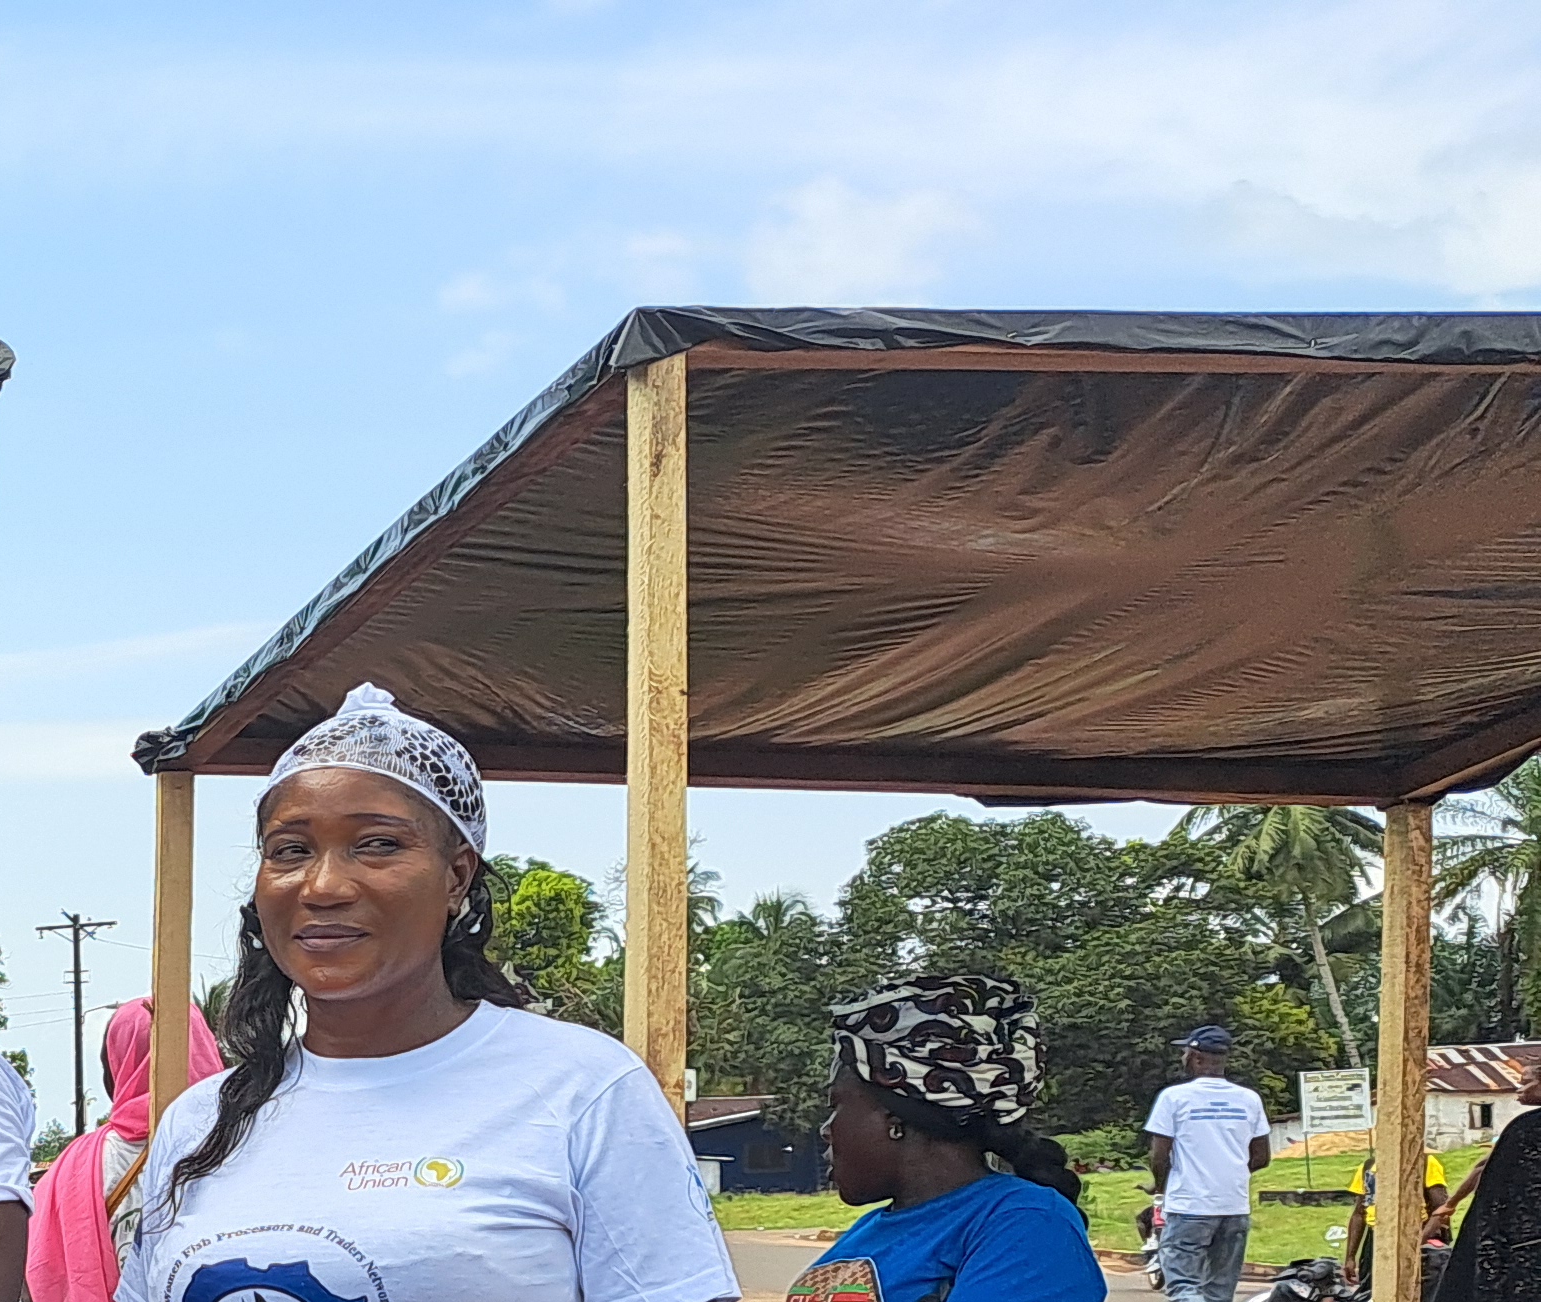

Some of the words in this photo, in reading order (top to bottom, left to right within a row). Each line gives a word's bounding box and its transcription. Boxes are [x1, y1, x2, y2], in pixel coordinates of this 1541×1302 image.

[339, 1158, 412, 1178] African
[347, 1173, 408, 1191] Union
[181, 1237, 212, 1260] Fish
[216, 1223, 295, 1242] Processors
[296, 1224, 324, 1237] and
[324, 1229, 367, 1267] Traders
